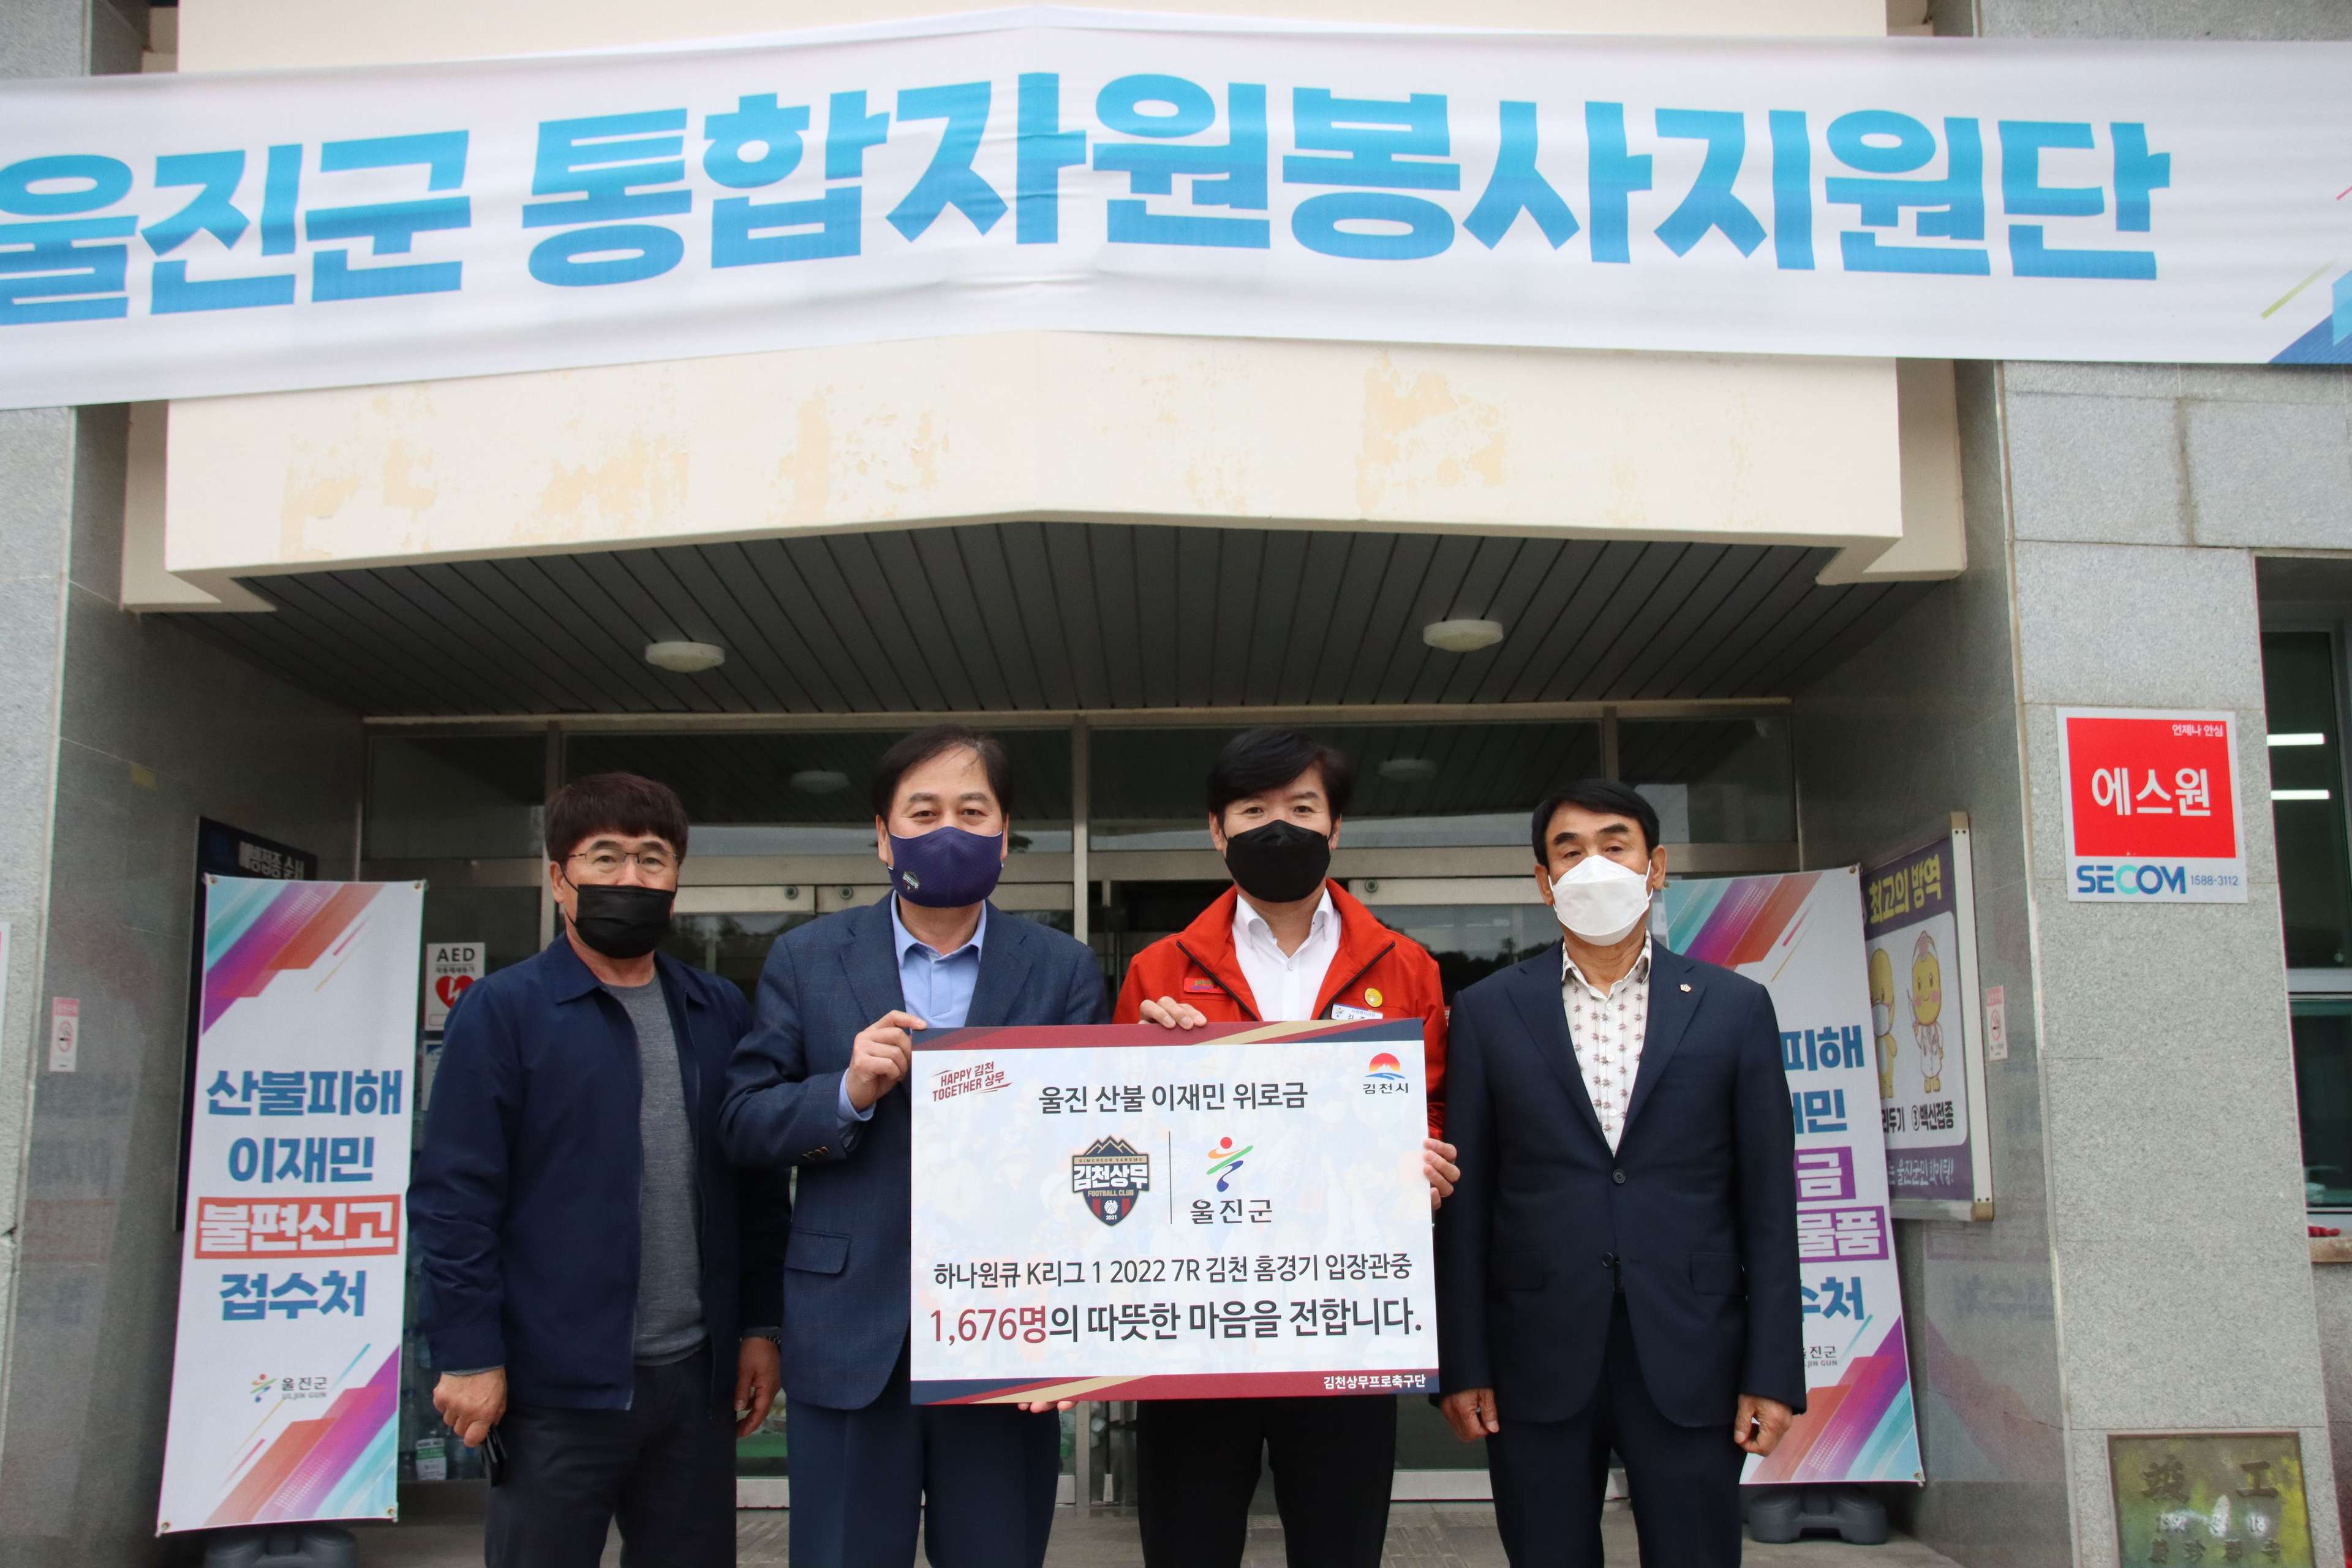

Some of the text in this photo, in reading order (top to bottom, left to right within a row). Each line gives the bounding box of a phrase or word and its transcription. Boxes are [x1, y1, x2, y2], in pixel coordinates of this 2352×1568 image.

[0, 72, 2171, 326] 울진군 통합자원봉사지원단
[2172, 723, 2224, 737] 언제나 안심
[2092, 767, 2211, 816] 에스원
[1869, 853, 1942, 924] 최고의 방역
[2076, 864, 2239, 895] SECOM 1588-3112
[437, 948, 475, 962] AED
[1780, 1025, 1865, 1072] 피해
[932, 1071, 1005, 1102] TOGETHER 상무
[941, 1061, 995, 1087] HAPPY 김천
[1363, 1082, 1409, 1095] 김천시
[206, 1069, 404, 1117] 산불피해
[1039, 1082, 1308, 1114] 울진 산불 이재민 위로금
[228, 1137, 375, 1183] 이재민
[1073, 1164, 1148, 1192] 김천상무
[1190, 1199, 1273, 1224] 울진군
[199, 1202, 394, 1253] 불편신고
[933, 1253, 1412, 1289] 하나원큐 K리그 1 2022 7R 김천 홈경기 입장관중
[219, 1270, 368, 1321] 접수처
[930, 1297, 1422, 1347] 1,676명의 따뜻한 마음을 전합니다.
[1803, 1346, 1836, 1359] 진군
[282, 1376, 327, 1392] 울진군
[1323, 1374, 1427, 1390] 김천상무프로축구단
